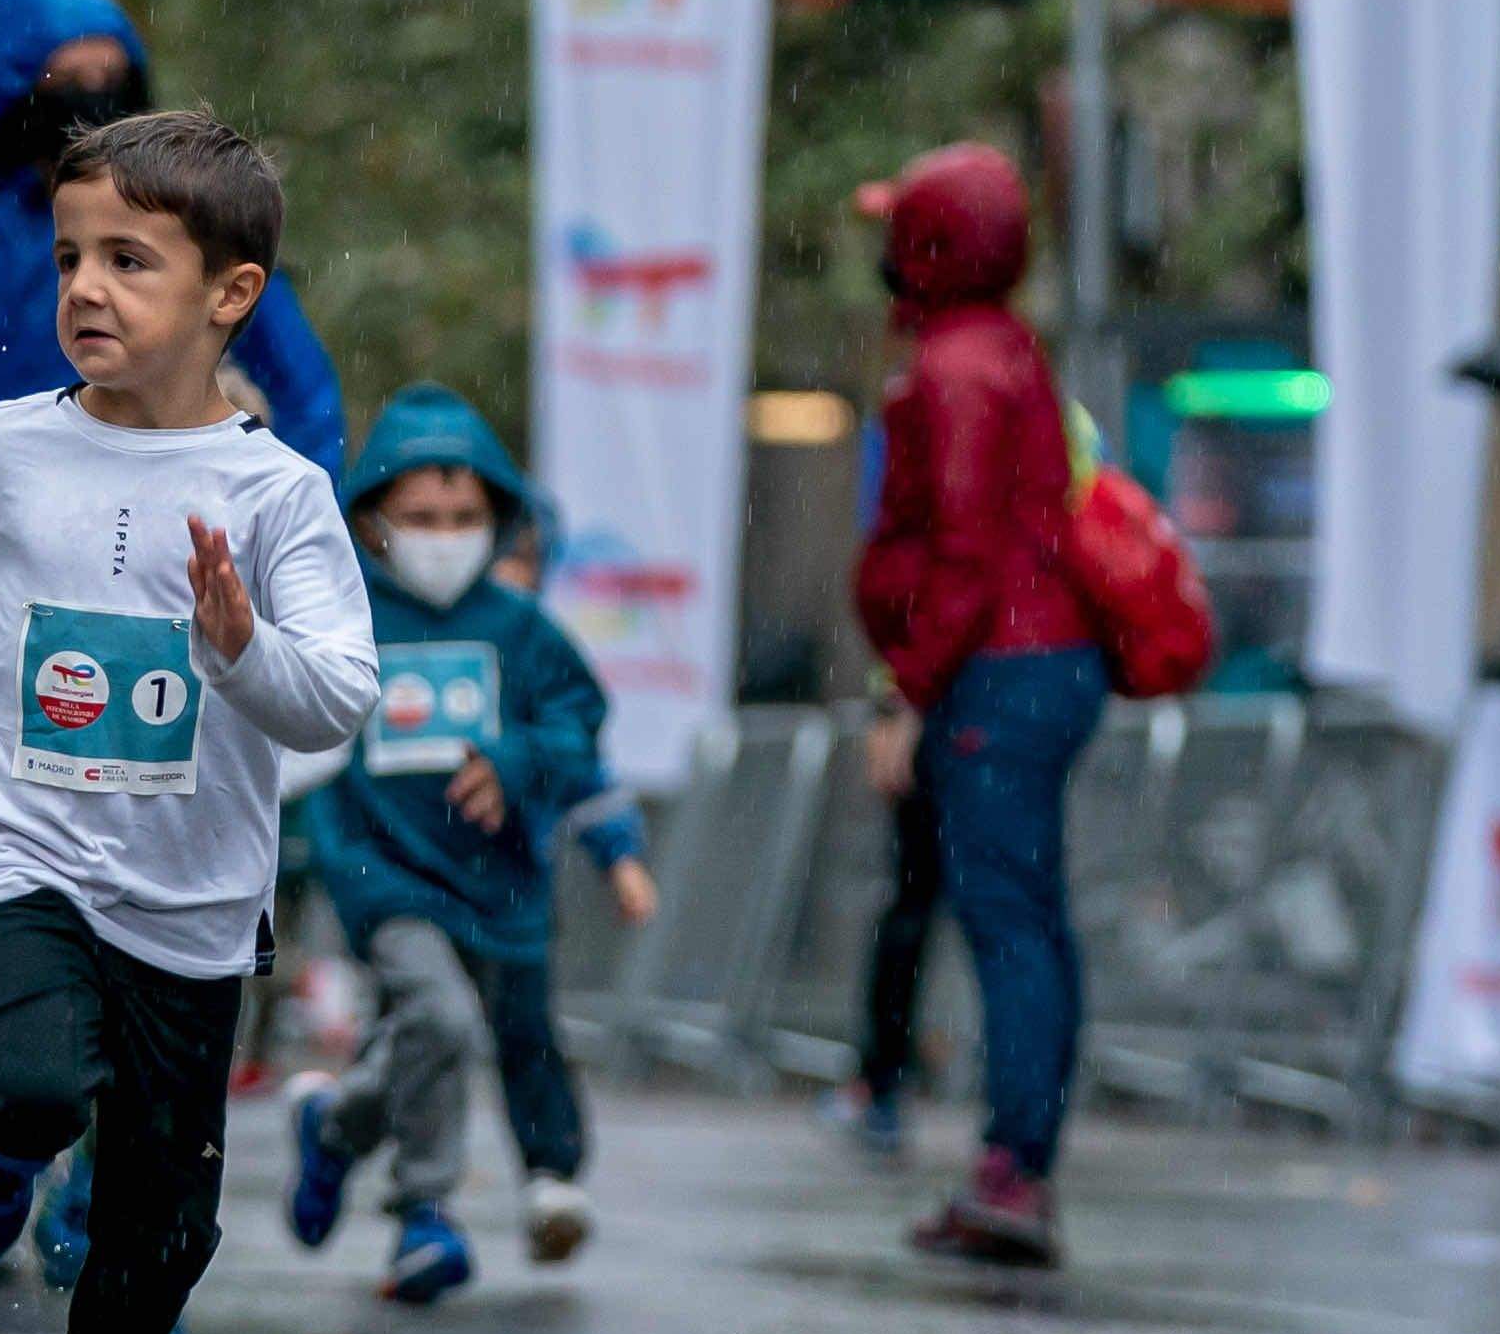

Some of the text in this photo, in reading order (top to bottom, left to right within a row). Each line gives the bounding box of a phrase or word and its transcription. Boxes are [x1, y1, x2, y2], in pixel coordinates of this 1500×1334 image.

[112, 509, 130, 576] KIPSTA
[151, 677, 167, 717] 1
[39, 763, 74, 776] MADRID
